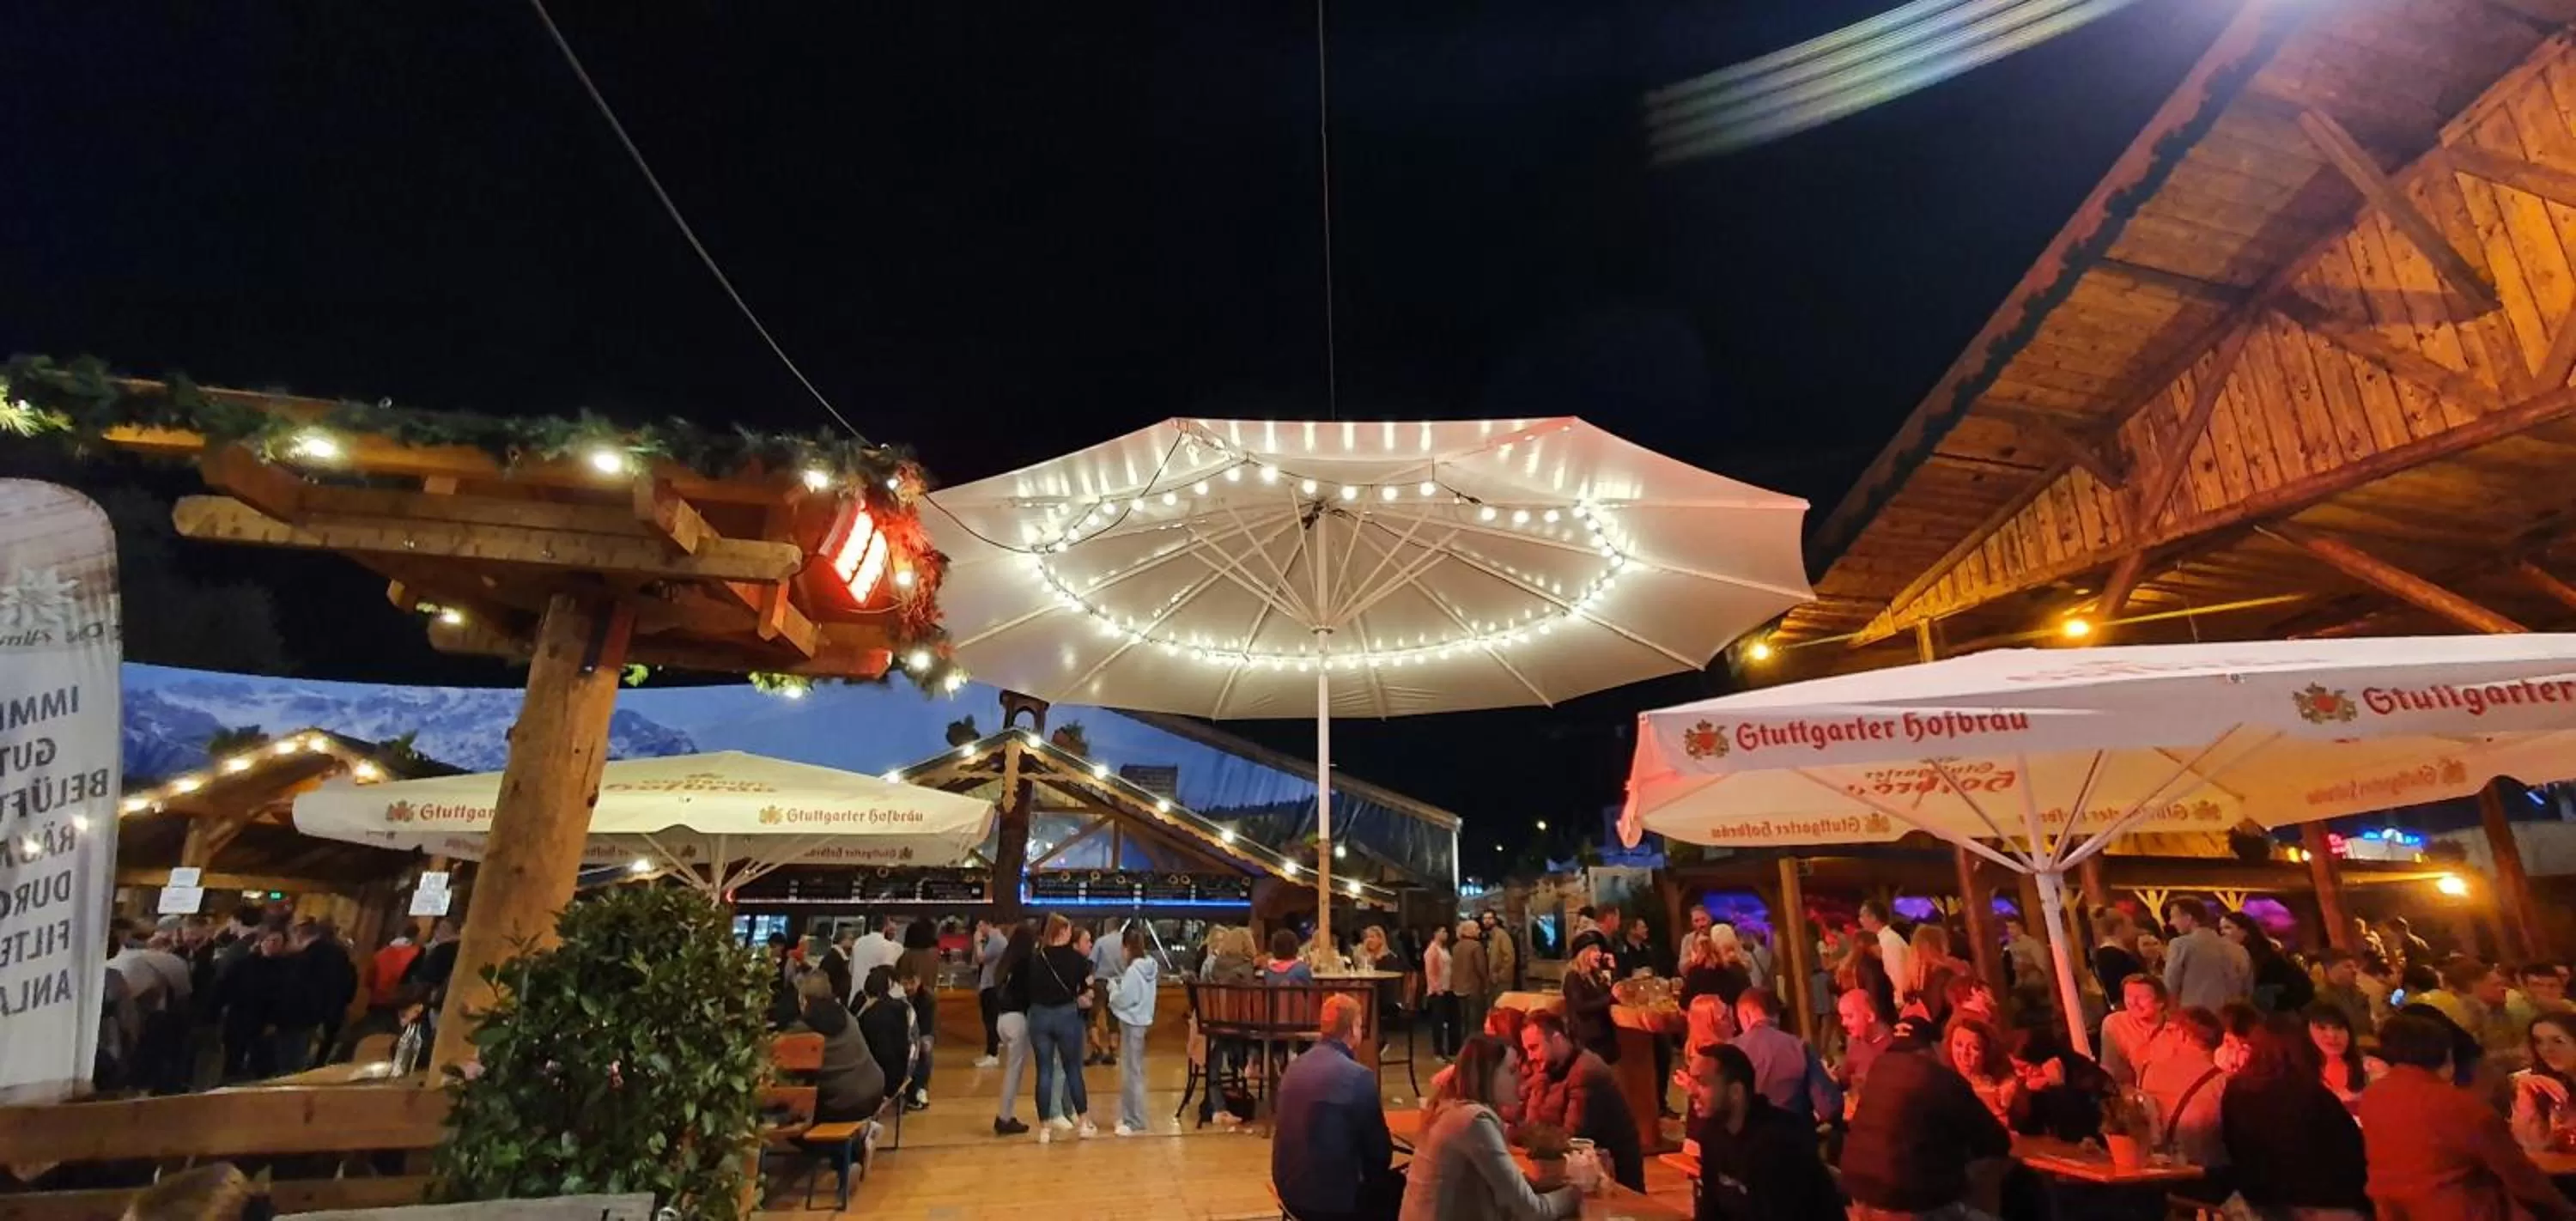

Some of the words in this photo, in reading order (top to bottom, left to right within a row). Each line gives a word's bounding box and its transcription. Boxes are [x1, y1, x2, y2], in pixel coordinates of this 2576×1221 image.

[2362, 679, 2574, 716] Stuttgarter
[1735, 716, 1895, 751] Stuttgarter
[1902, 708, 2030, 743] Hofbräu
[420, 803, 496, 823] Stuttgar
[786, 807, 865, 825] Stuttgarter
[868, 807, 924, 825] Hofbräu
